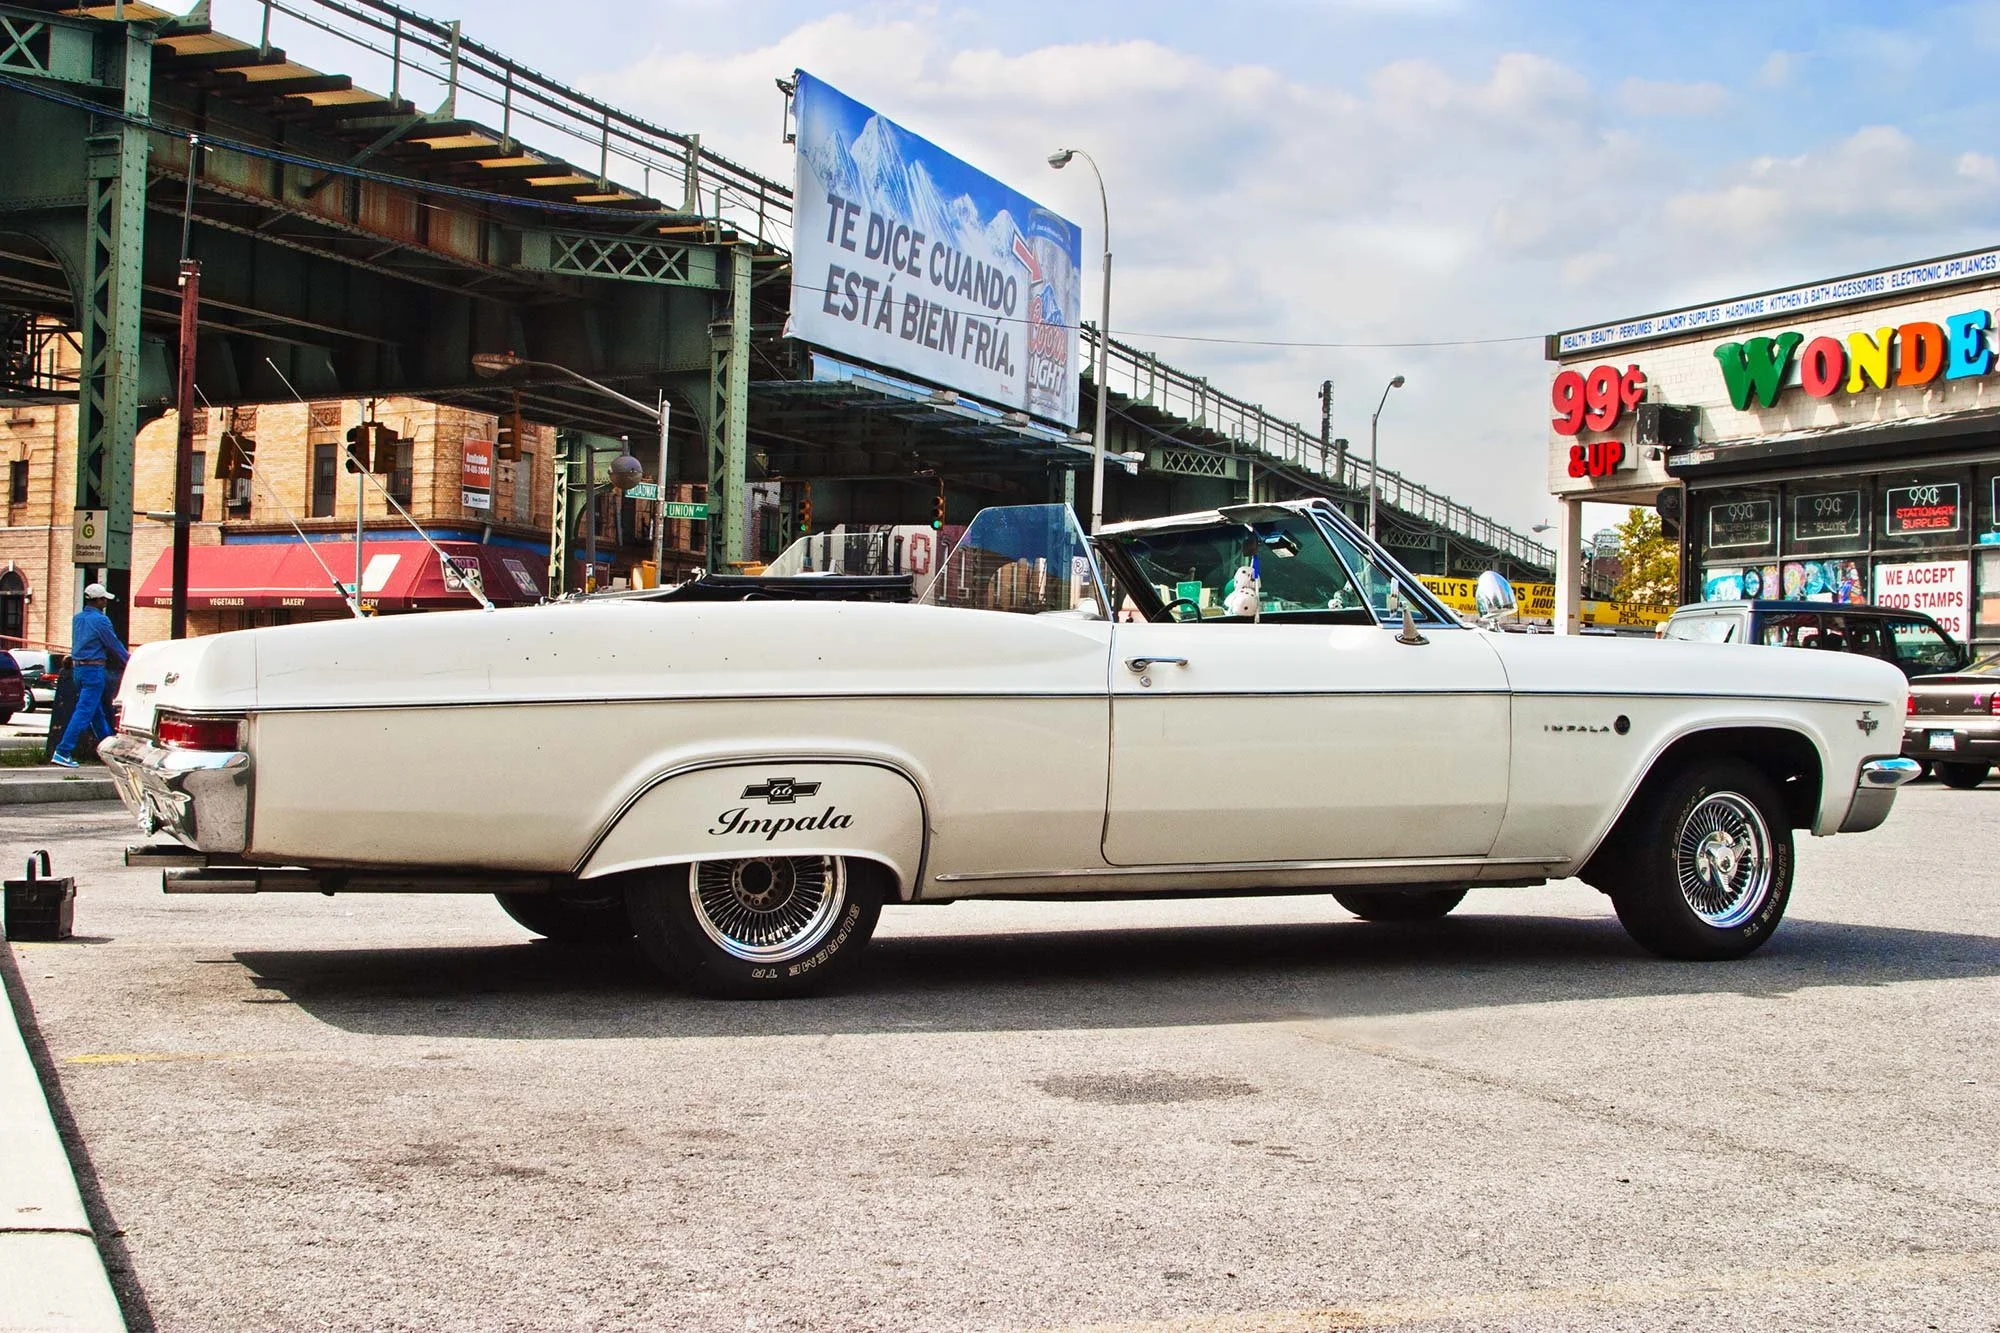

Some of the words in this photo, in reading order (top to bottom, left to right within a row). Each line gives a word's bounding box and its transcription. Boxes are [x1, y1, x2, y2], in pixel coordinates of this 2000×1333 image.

[827, 192, 861, 252] TE
[865, 211, 925, 279] DICE
[929, 241, 1017, 317] CUANDO
[1563, 334, 1587, 349] HEALTH
[1590, 328, 1615, 344] BEAUTY
[1619, 321, 1652, 339] PERFUMES
[1657, 314, 1687, 332] LAUNDRY
[1688, 308, 1720, 325] SUPPLIES
[1725, 300, 1764, 319] HARDWARE
[1770, 292, 1801, 310] KITCHEN
[1803, 292, 1809, 304] &
[1811, 287, 1830, 303] BATH
[1832, 276, 1885, 298] ACCESSORIES
[1892, 265, 1941, 288] ELECTRONIC
[1944, 254, 1996, 277] APPLIANCES
[822, 263, 896, 334] ESTÁ
[901, 292, 959, 355] BIEN
[961, 317, 1014, 378] FRÍA.
[1713, 308, 2000, 411] WONDE
[1028, 355, 1065, 397] LIGHT
[1552, 364, 1647, 436] 99¢
[1909, 487, 1940, 507] 99¢
[669, 504, 694, 517] UNION
[1902, 517, 1950, 530] SUPPLIES
[1885, 570, 1903, 586] WE
[1907, 567, 1955, 585] ACCEPT
[154, 597, 173, 606] FRUITS
[209, 598, 245, 606] VEGETABLES
[282, 598, 306, 606] BAKERY
[1610, 603, 1669, 615] STUFFED
[1878, 593, 1910, 609] FOOD
[1914, 591, 1963, 609] STAMPS
[1618, 618, 1659, 627] PLANTS
[1619, 611, 1641, 619] SOIL
[770, 784, 793, 797] 66
[708, 806, 854, 841] Impala
[788, 903, 861, 977] SUPREME
